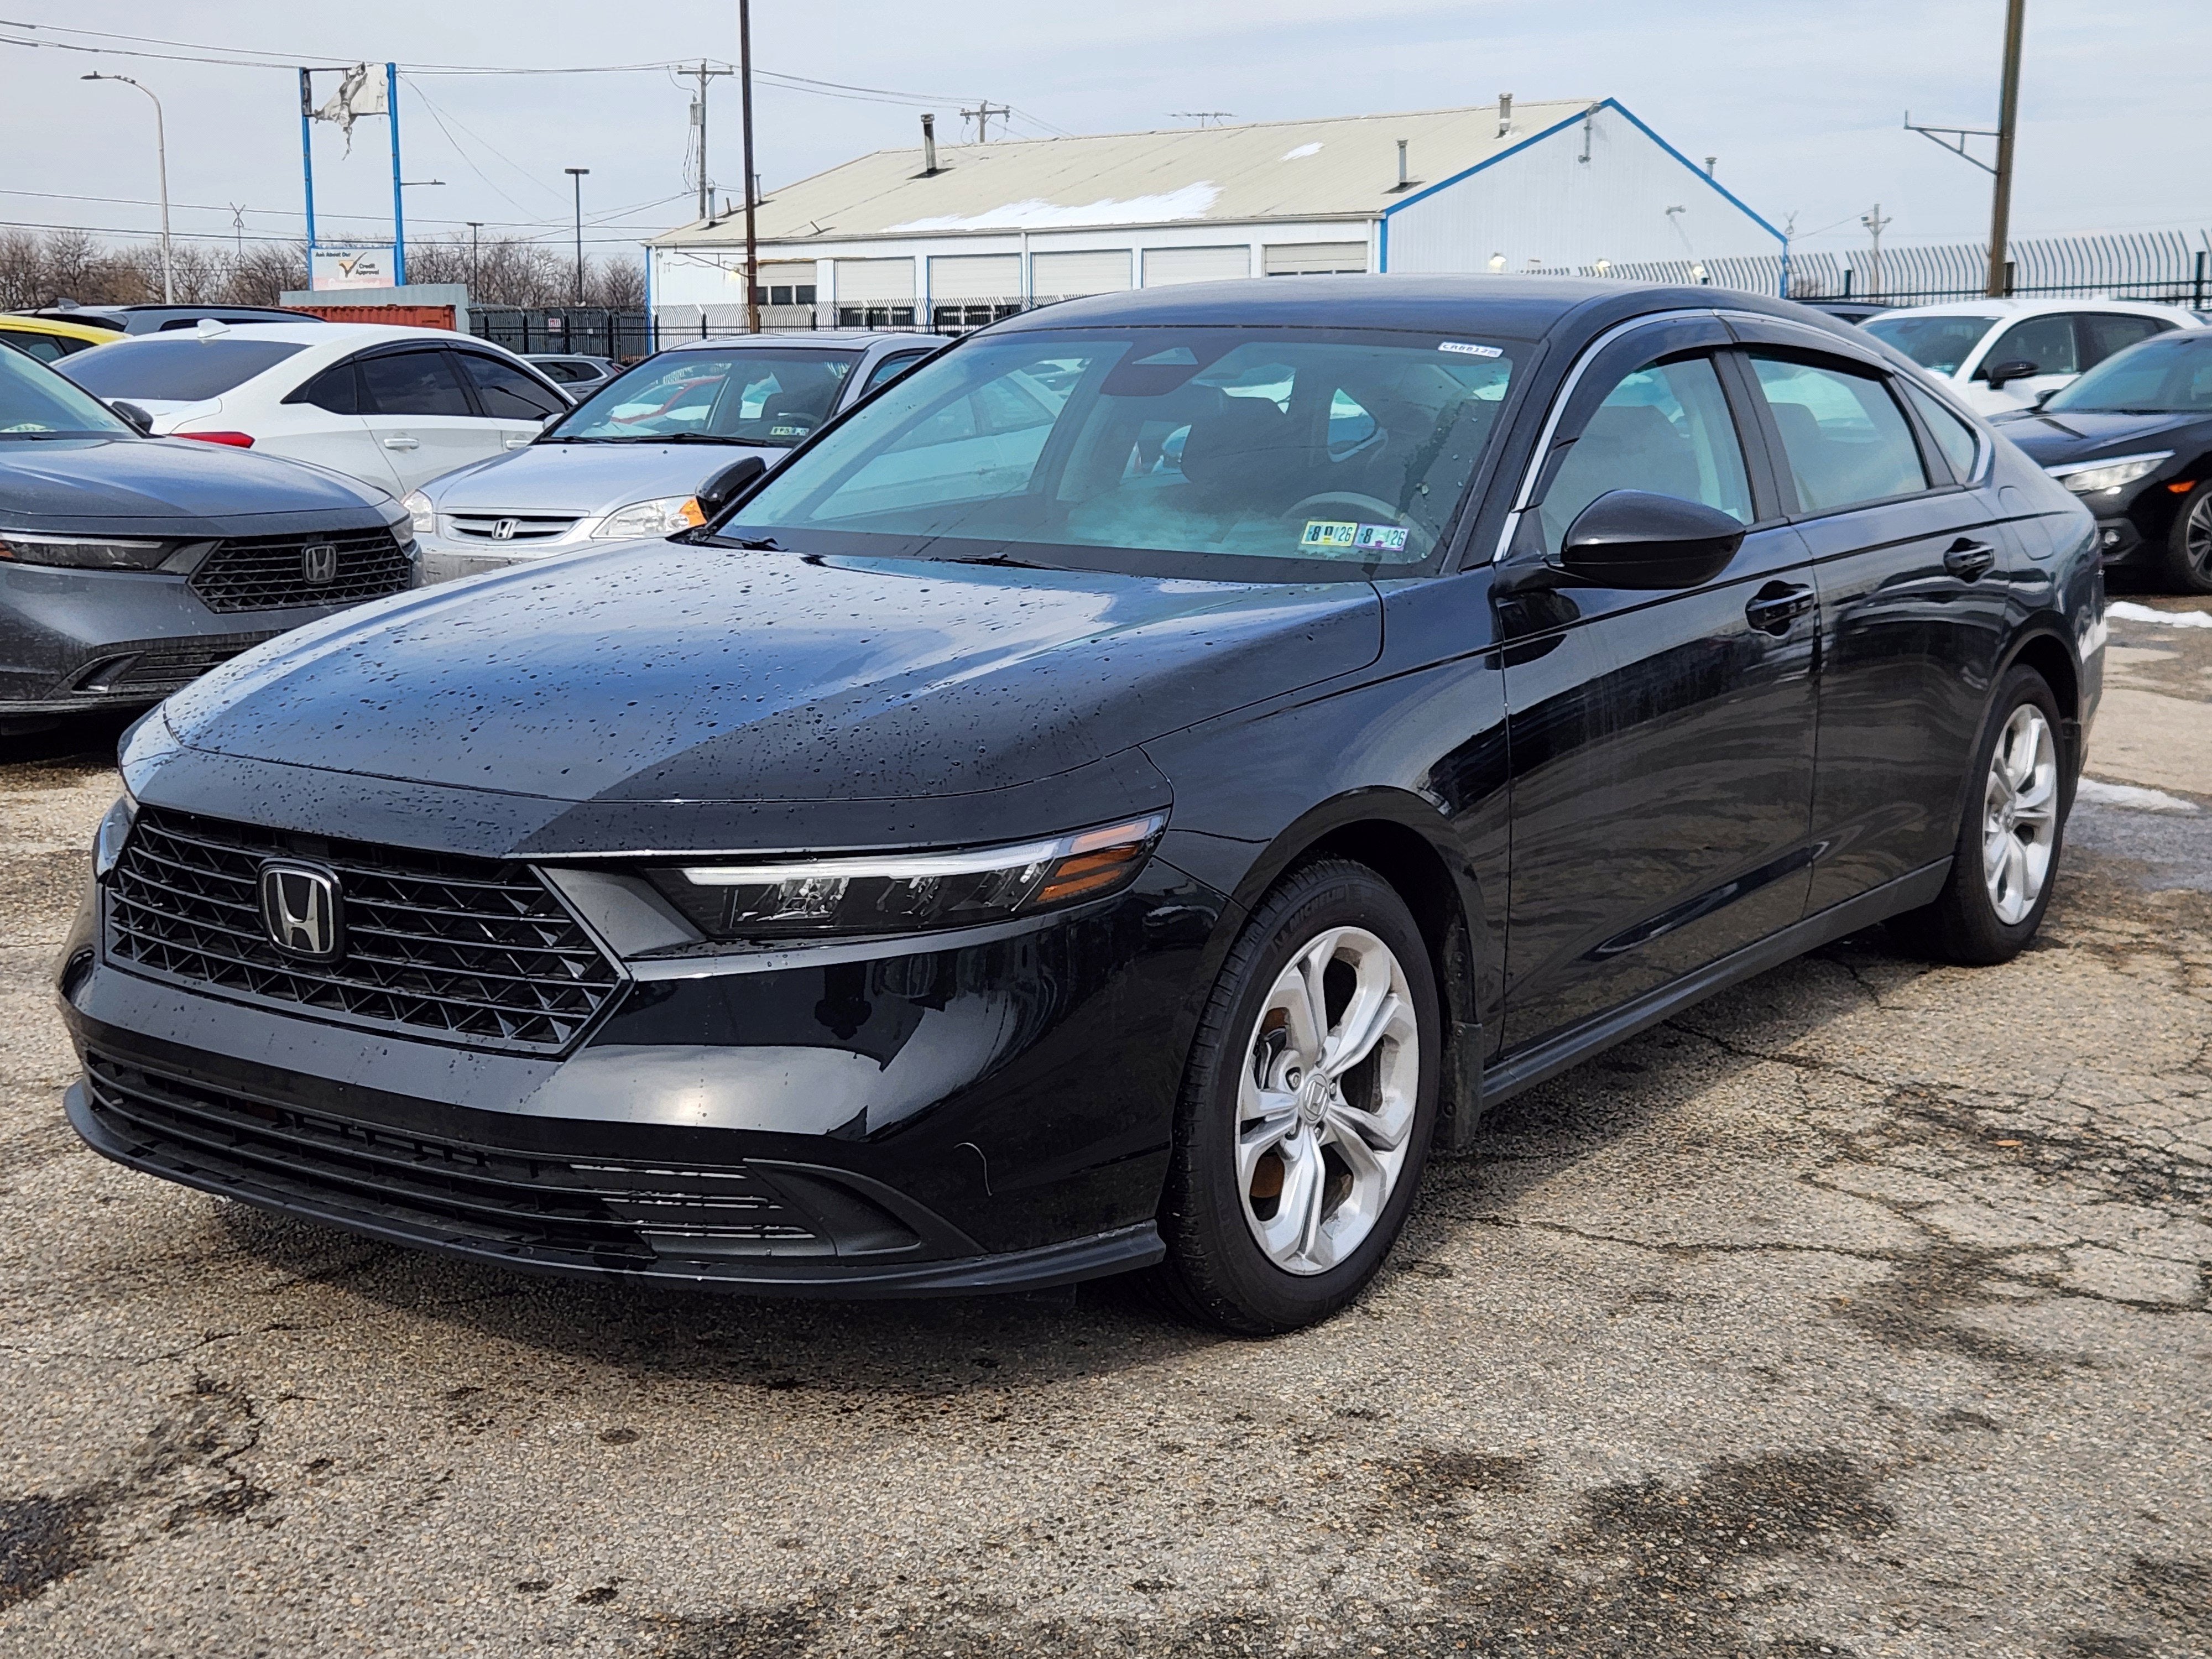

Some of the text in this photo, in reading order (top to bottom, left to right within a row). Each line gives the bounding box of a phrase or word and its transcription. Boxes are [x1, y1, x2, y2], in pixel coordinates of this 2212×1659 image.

[1311, 526, 1353, 542] 8 26
[1363, 528, 1405, 546] 8 26
[1290, 886, 1345, 932] MICHELIN
